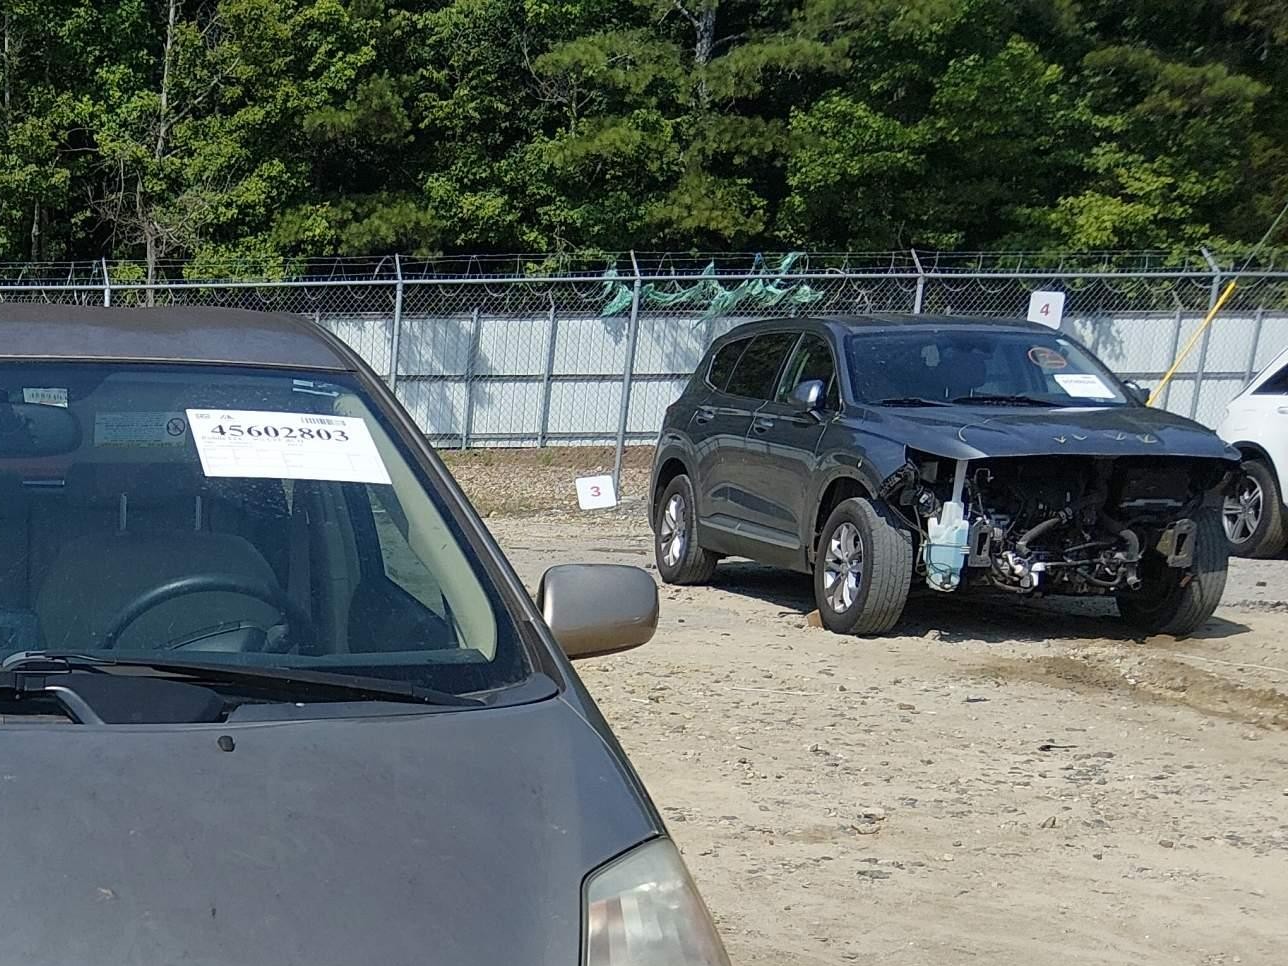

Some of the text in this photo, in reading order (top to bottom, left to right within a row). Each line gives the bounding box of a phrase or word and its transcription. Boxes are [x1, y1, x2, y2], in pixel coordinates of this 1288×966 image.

[1039, 303, 1050, 316] 4
[210, 424, 350, 442] 45602803
[590, 486, 601, 497] 3
